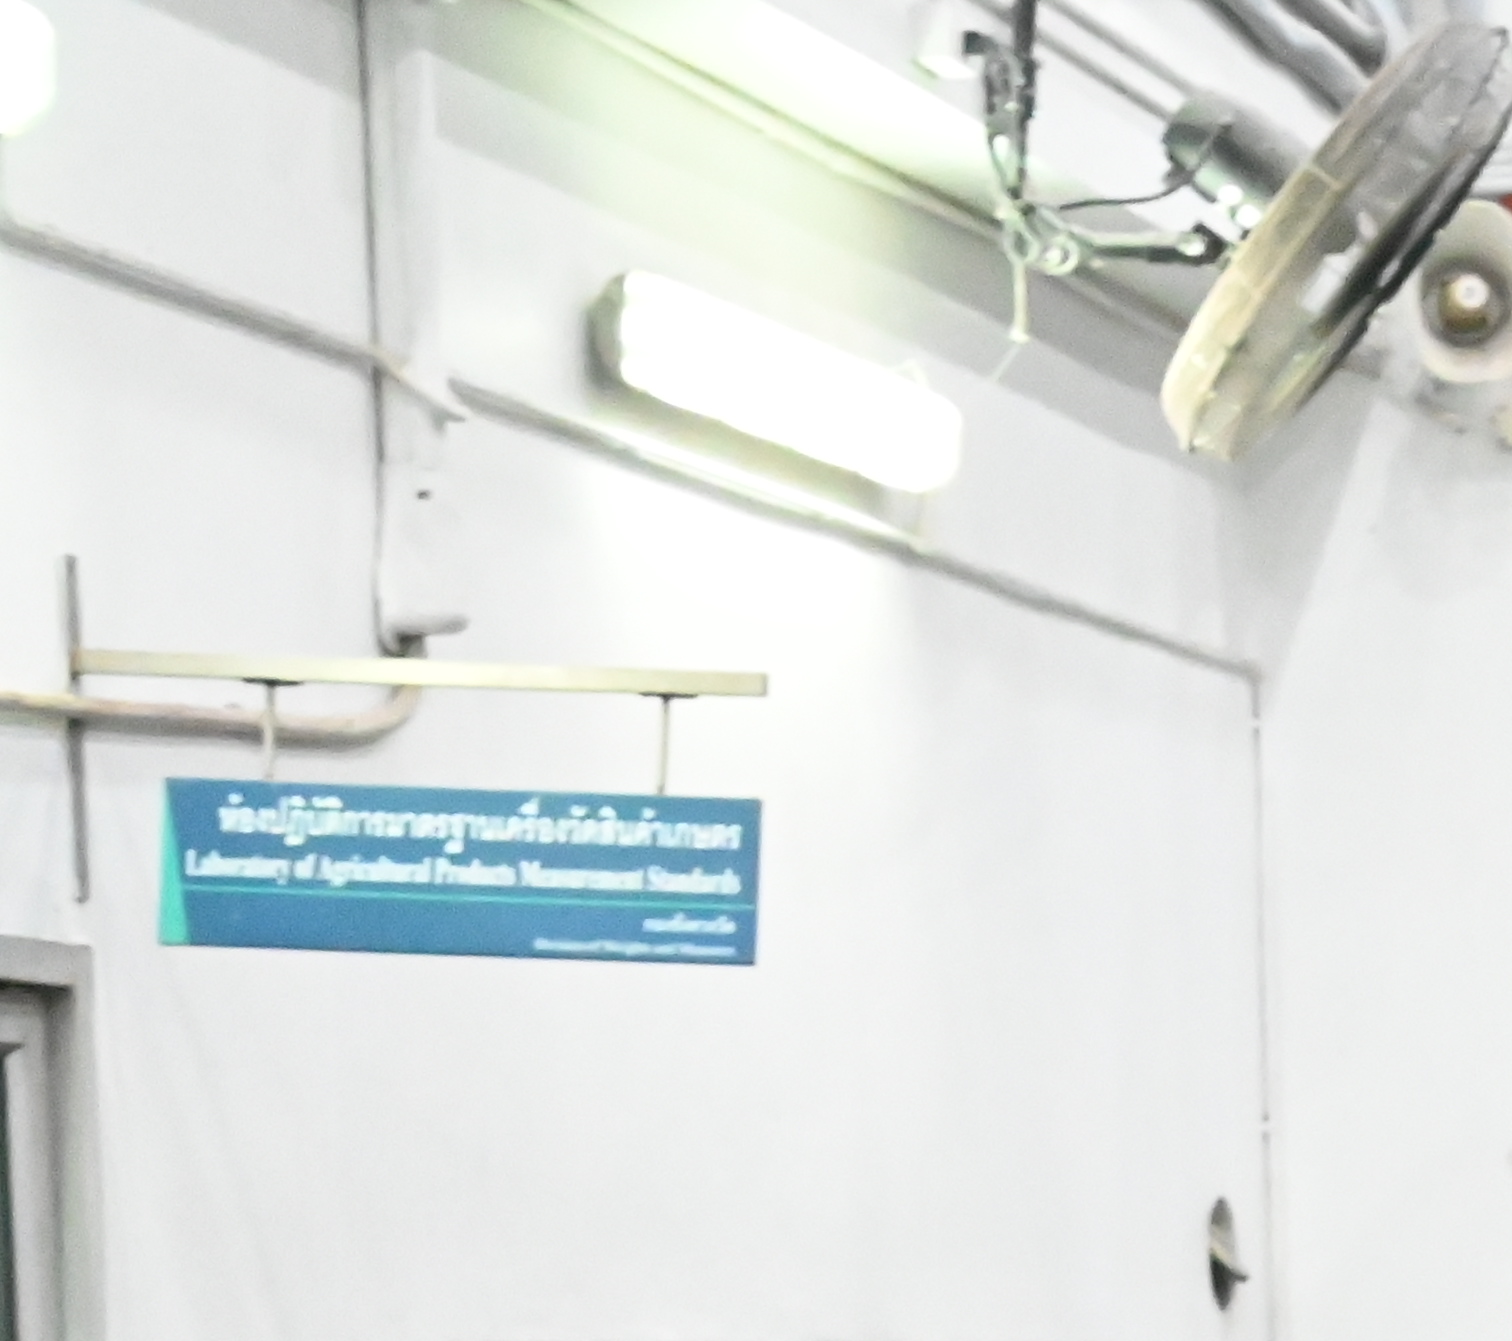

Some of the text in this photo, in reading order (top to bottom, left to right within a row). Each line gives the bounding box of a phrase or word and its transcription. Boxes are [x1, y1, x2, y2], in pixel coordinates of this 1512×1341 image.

[185, 848, 742, 895] Laboratory of Agricultural Products Measurement Standards
